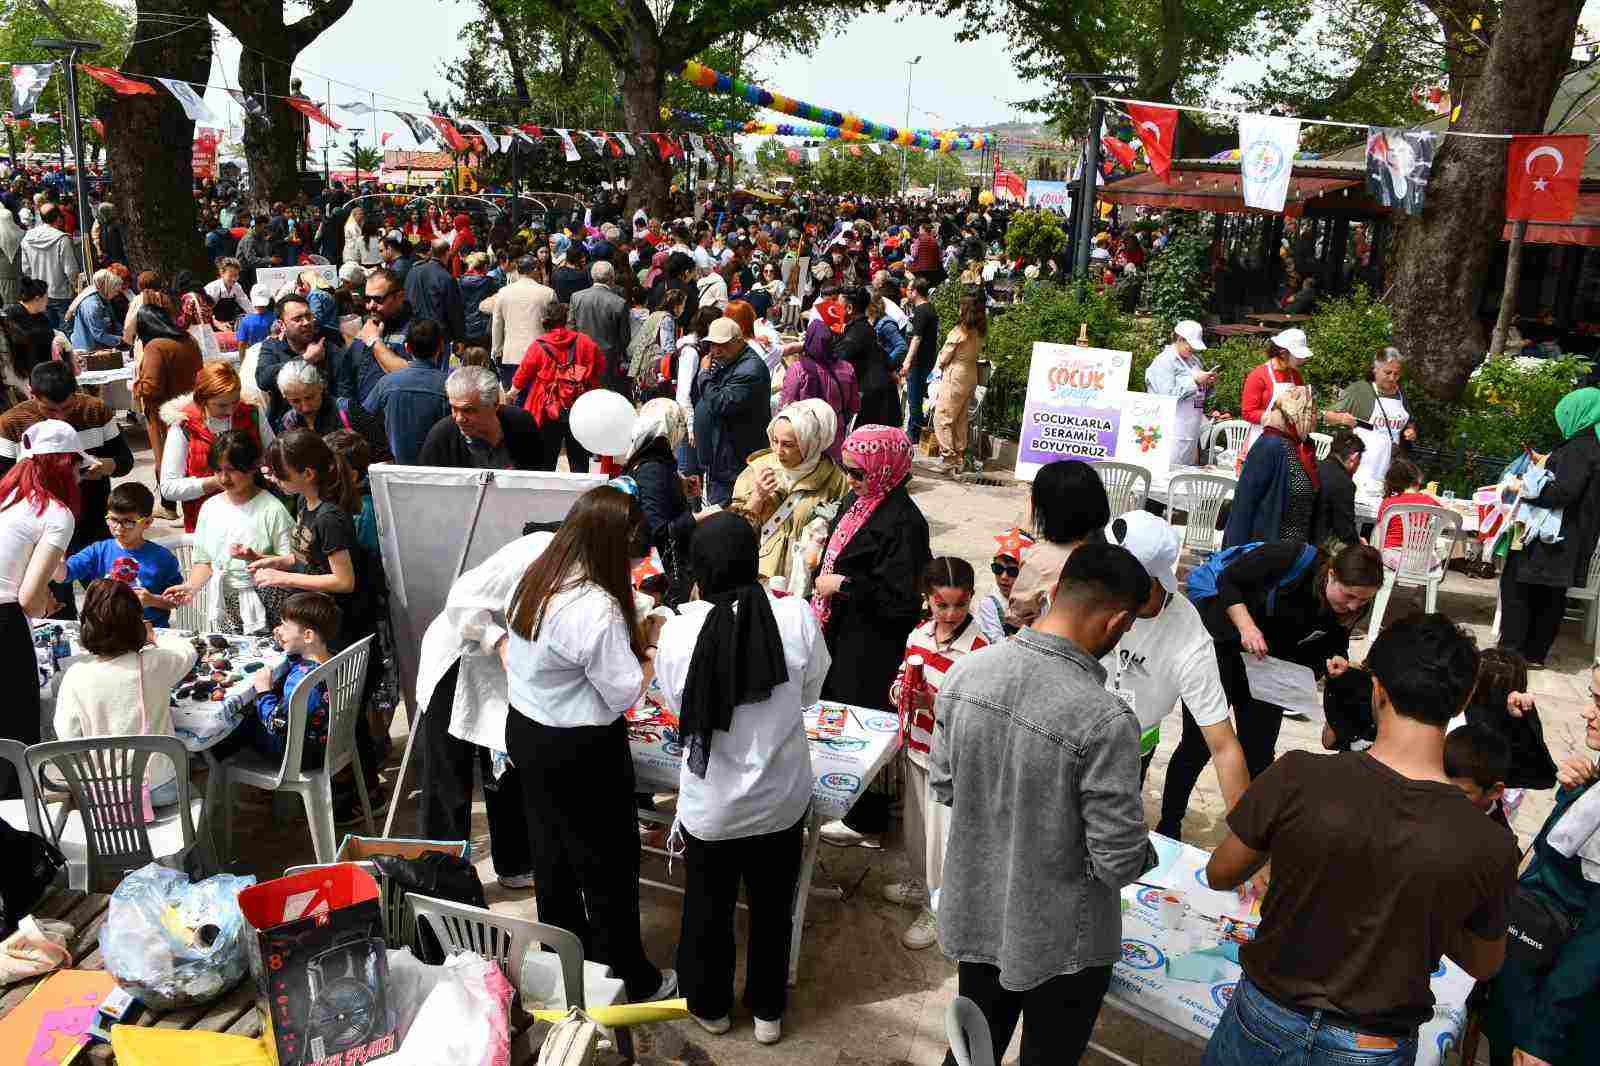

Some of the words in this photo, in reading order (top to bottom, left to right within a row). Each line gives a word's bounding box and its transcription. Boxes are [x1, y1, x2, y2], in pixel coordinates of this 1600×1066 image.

[1033, 412, 1111, 431] ÇOCUKLARLA
[1044, 427, 1097, 442] SERAMİK
[1032, 440, 1105, 457] BOYUYORUZ
[1520, 931, 1543, 950] Jeans
